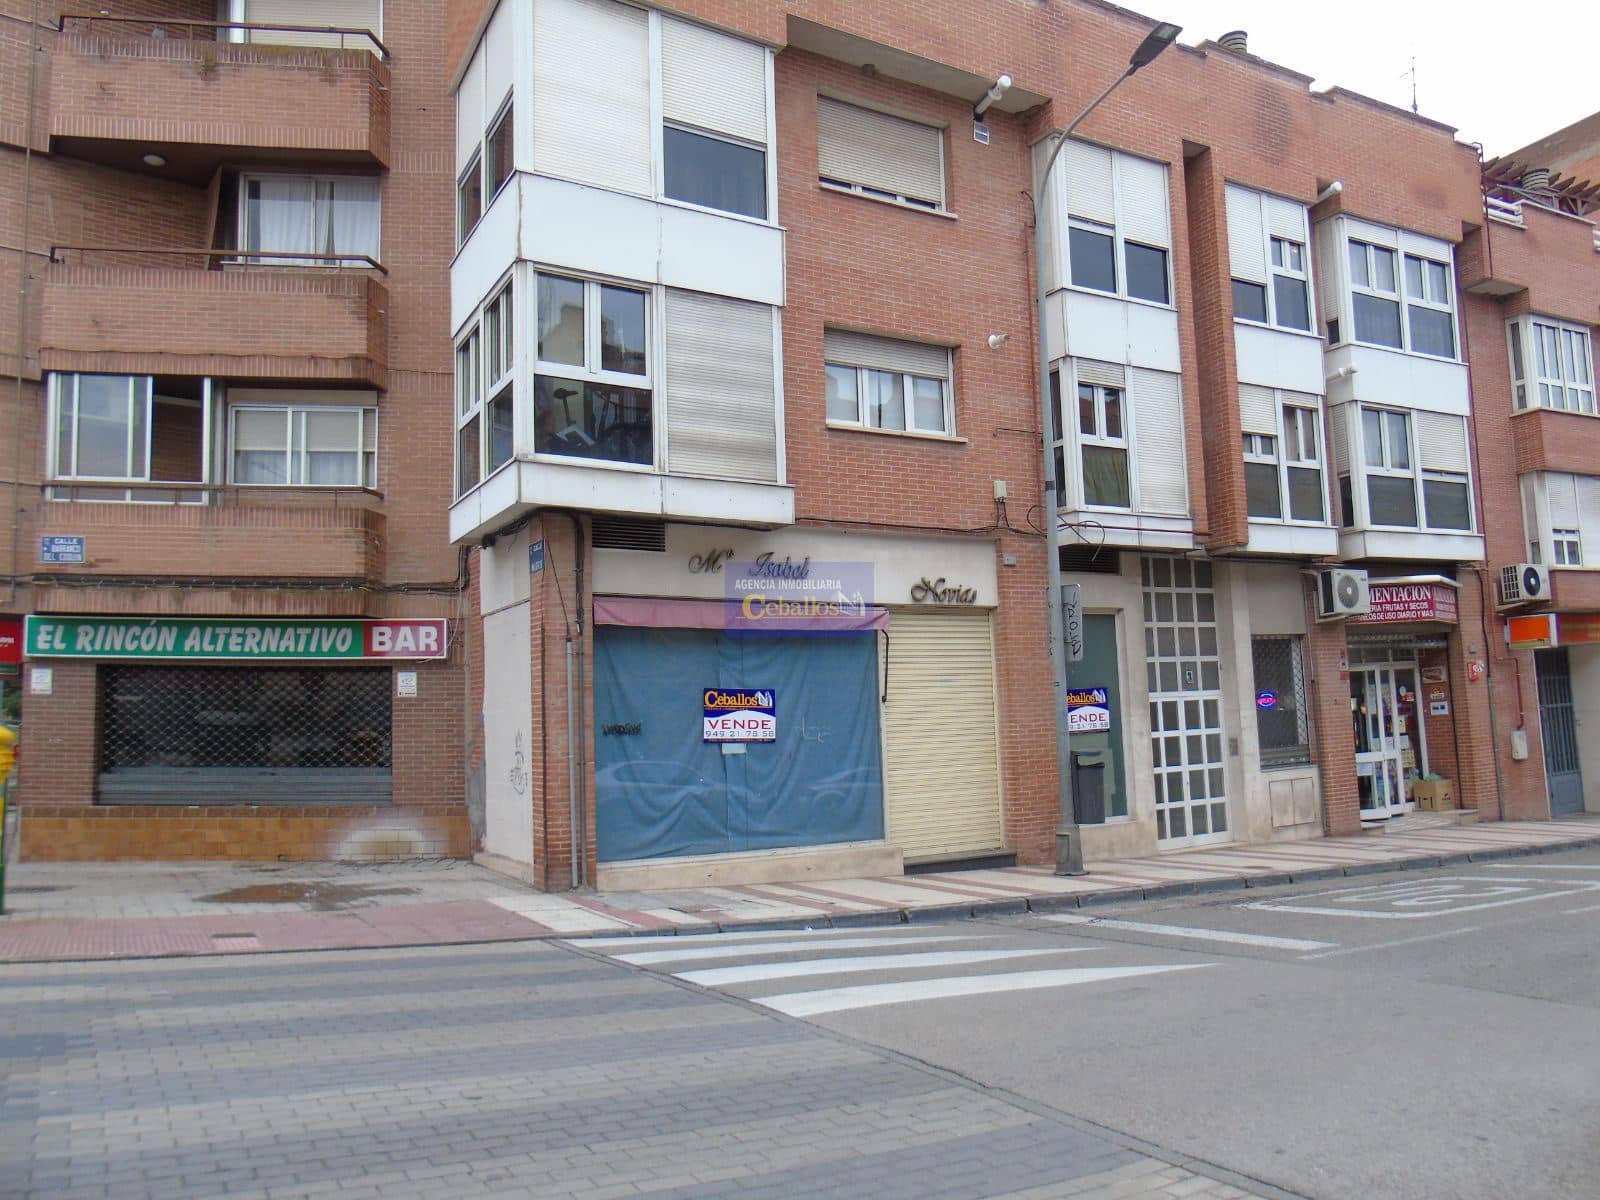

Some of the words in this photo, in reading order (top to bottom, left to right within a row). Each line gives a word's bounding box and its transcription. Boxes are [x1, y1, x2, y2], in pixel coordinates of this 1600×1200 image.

[748, 551, 810, 579] Isabel
[910, 576, 978, 604] Novias
[1382, 603, 1404, 611] FRUTAS
[1409, 602, 1429, 610] SECOS
[37, 624, 67, 650] EL
[75, 619, 178, 653] RINCÓN
[184, 625, 353, 654] ALTERNATIVO
[371, 625, 438, 653] BAR
[704, 690, 758, 708] Ceballos
[1066, 692, 1095, 704] eballos
[708, 719, 772, 730] VENDE
[1070, 713, 1106, 724] ENDE
